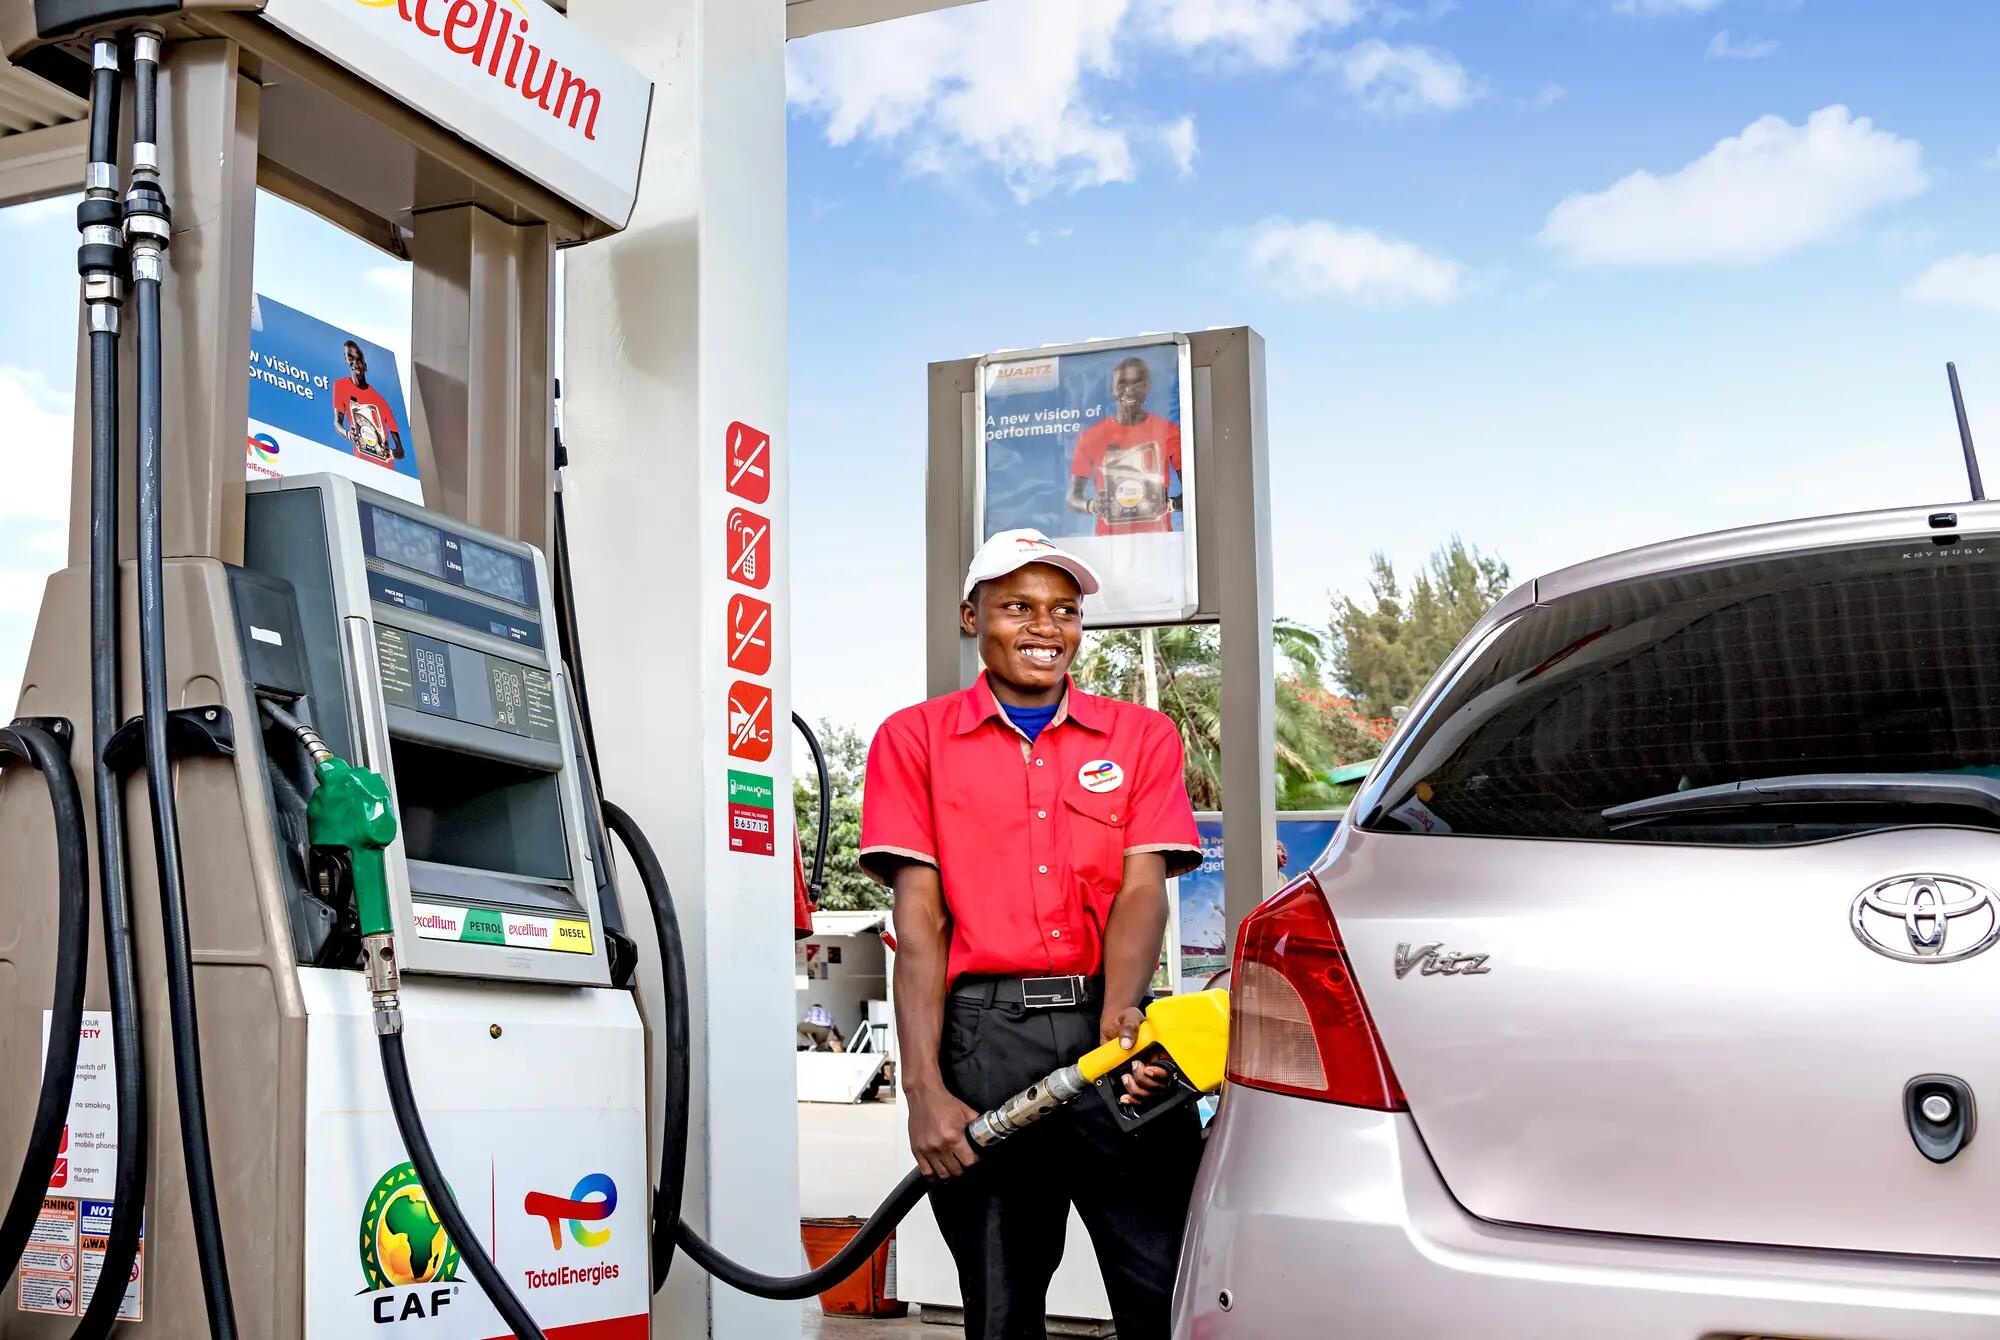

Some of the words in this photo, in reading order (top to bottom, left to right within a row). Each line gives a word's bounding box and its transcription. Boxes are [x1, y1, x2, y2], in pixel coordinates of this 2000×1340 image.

[398, 0, 602, 141] cellium
[263, 354, 310, 383] vision
[313, 375, 329, 391] of
[249, 365, 314, 400] ormance
[986, 415, 996, 427] A
[1000, 411, 1030, 425] new
[1034, 406, 1080, 422] vision
[1085, 404, 1101, 418] of
[986, 422, 1081, 442] performance
[446, 540, 458, 550] KSh
[446, 560, 462, 572] Litres
[735, 818, 768, 832] 865712
[413, 914, 457, 931] excellium
[469, 920, 503, 934] PETROL
[508, 923, 549, 938] excellium
[559, 927, 587, 939] DIESEL
[1394, 941, 1492, 980] Vitz
[79, 1029, 101, 1038] FETY
[97, 1063, 107, 1071] off
[76, 1072, 97, 1081] engine
[84, 1102, 111, 1111] smoking
[74, 1131, 94, 1139] switch
[83, 1167, 99, 1175] open
[74, 1175, 94, 1183] flames
[42, 1199, 75, 1210] RNING
[90, 1206, 113, 1216] NOT
[525, 1261, 619, 1289] TotalEnergies
[373, 1288, 451, 1324] CAF
